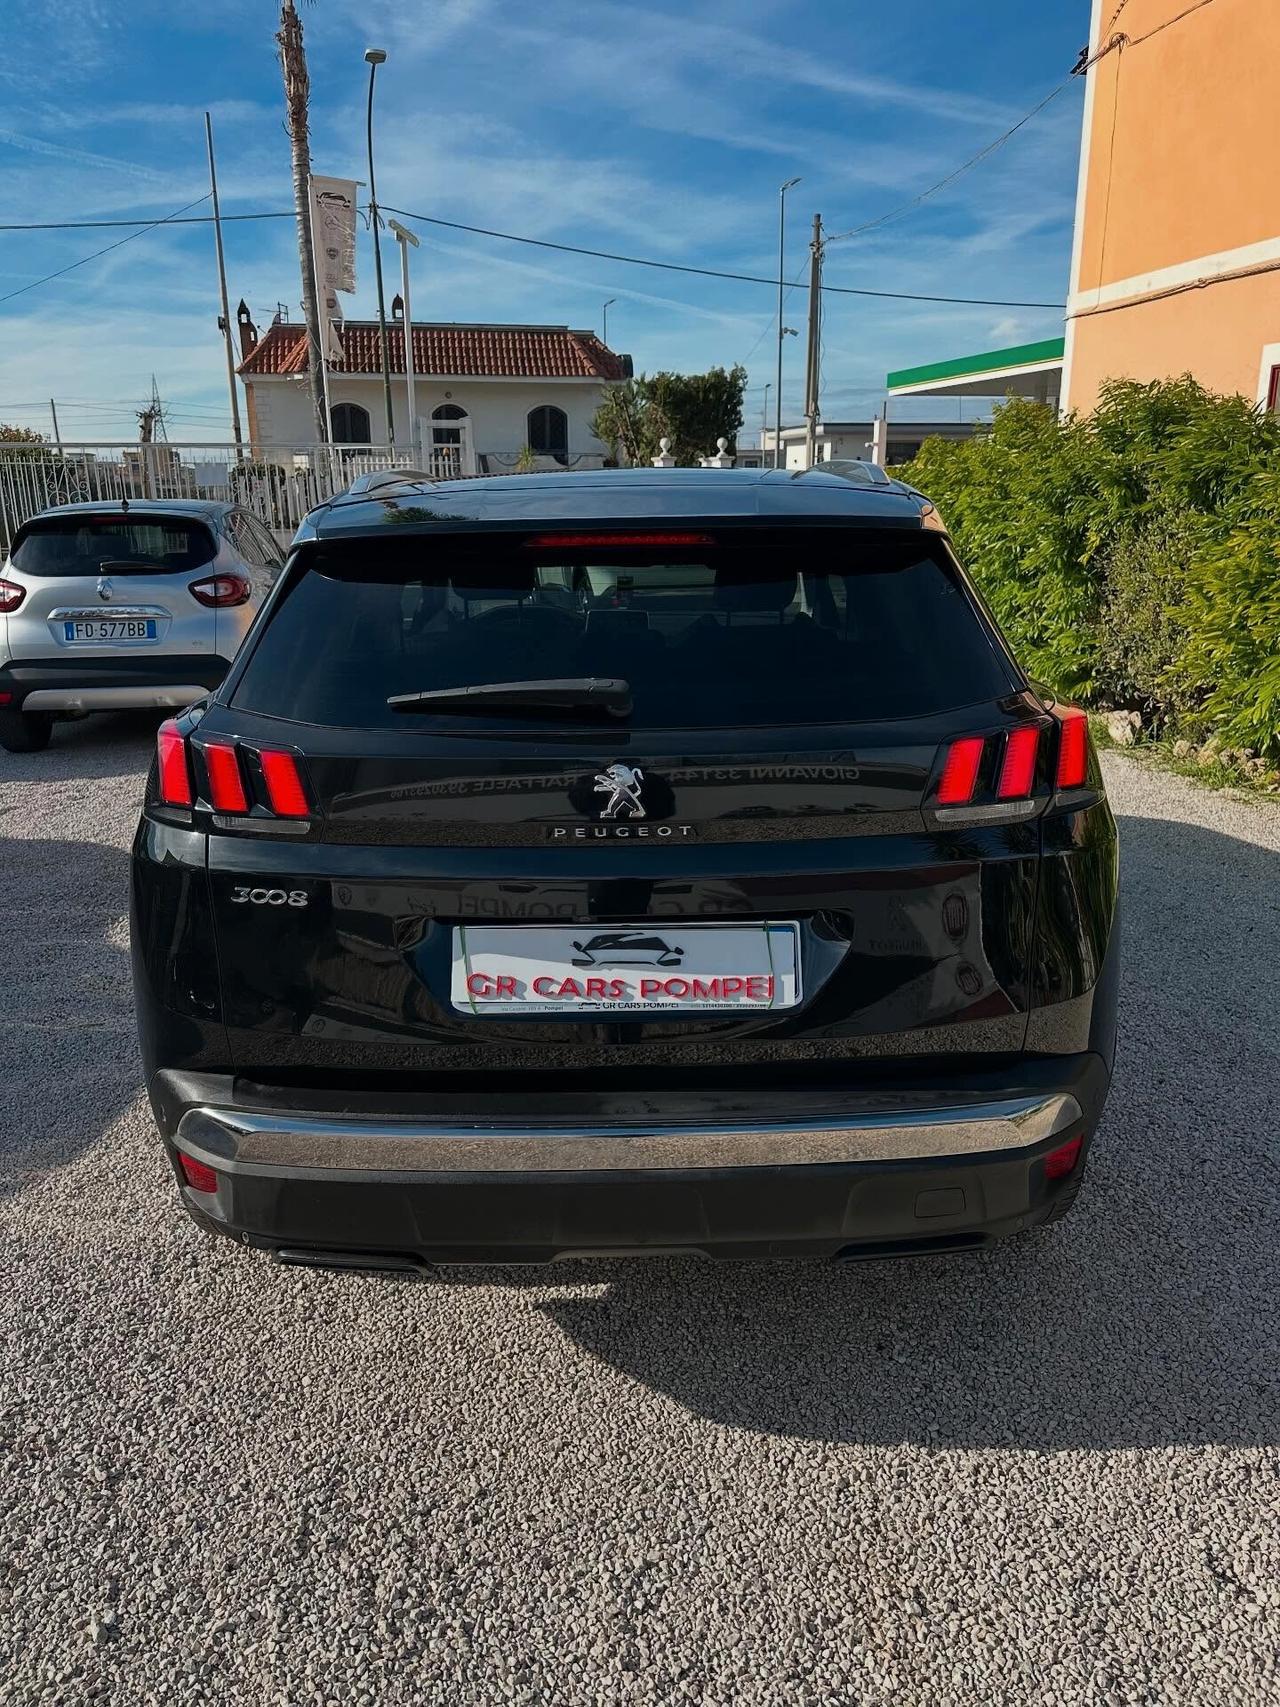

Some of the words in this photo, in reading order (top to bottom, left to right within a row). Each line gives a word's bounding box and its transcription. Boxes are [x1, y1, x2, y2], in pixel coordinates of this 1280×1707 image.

[75, 623, 94, 638] FD
[100, 622, 146, 637] 577BB
[553, 825, 692, 838] PEUGEOT
[230, 886, 309, 907] 3008
[466, 972, 517, 998] GR
[532, 975, 624, 999] CARS
[640, 975, 775, 999] POMPEI
[616, 1001, 641, 1009] CARS
